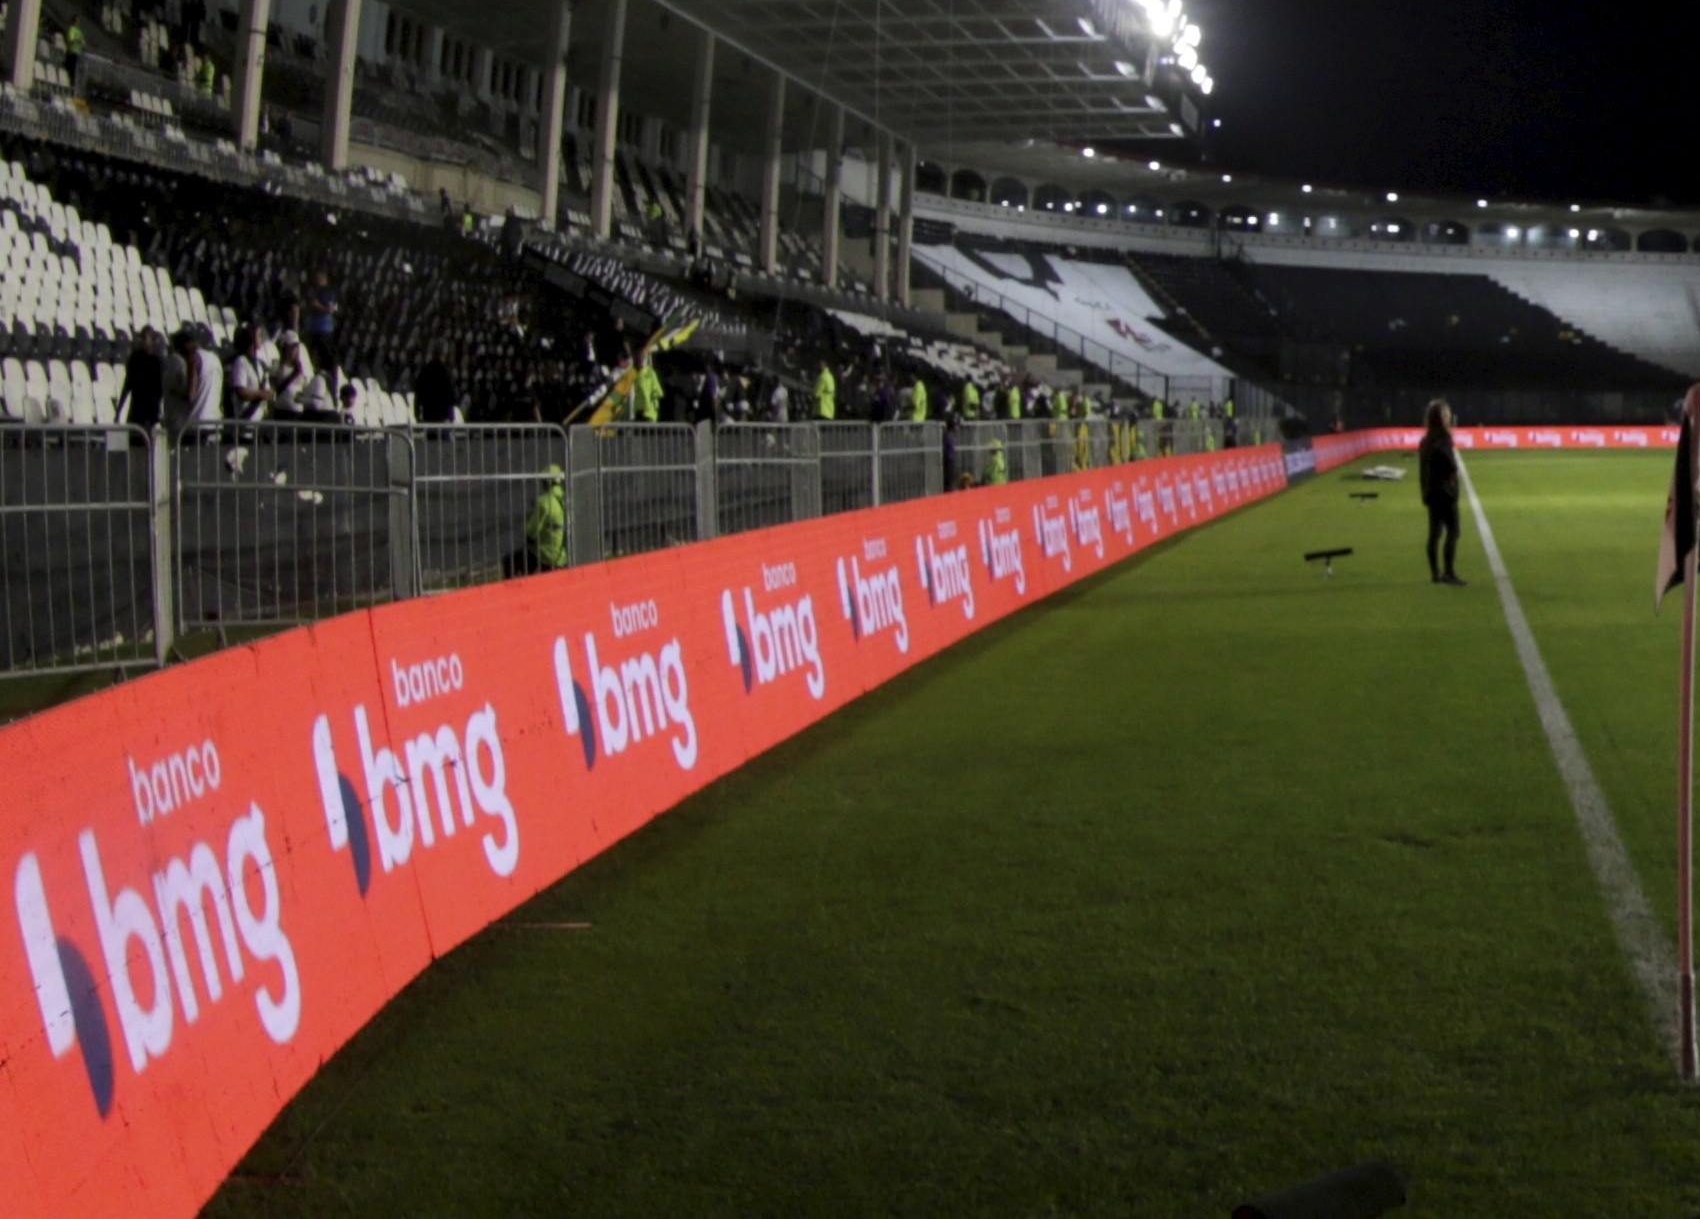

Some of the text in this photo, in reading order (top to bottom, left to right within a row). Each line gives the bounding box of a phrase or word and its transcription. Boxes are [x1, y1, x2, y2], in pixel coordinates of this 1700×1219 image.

[611, 599, 658, 638] banco
[762, 561, 797, 592] banco
[851, 555, 909, 654] bmg
[391, 653, 464, 708] banco
[743, 586, 826, 701] bmg
[584, 631, 698, 771] bmg
[128, 739, 221, 826] banco
[353, 701, 520, 878] bmg
[78, 801, 302, 1074] bmg
